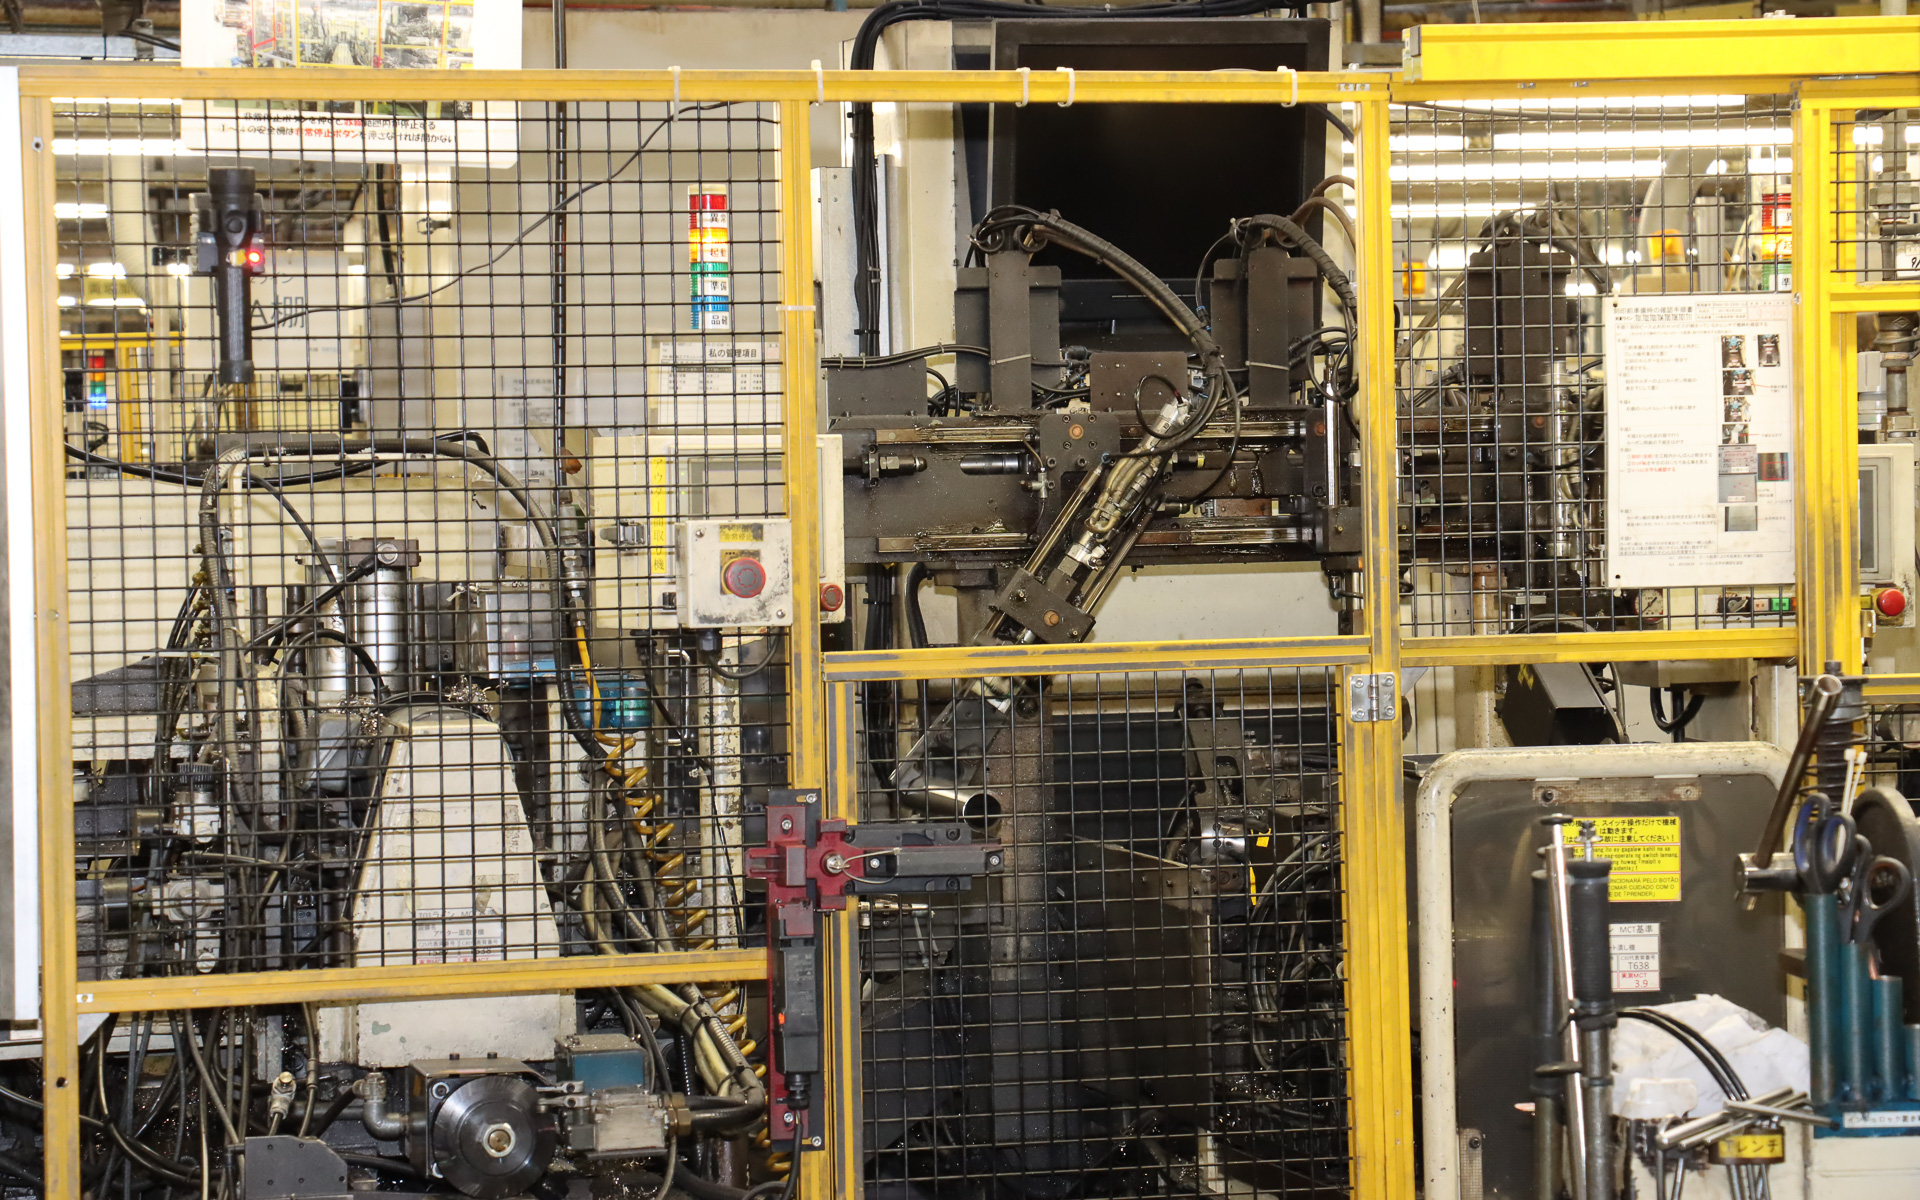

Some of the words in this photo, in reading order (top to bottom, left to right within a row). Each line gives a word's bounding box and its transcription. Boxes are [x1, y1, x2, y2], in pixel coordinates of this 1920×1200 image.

[709, 348, 757, 358] 私の管理項目
[1620, 925, 1654, 933] MCT基準
[1628, 962, 1650, 970] T638
[1635, 979, 1649, 988] 3.9
